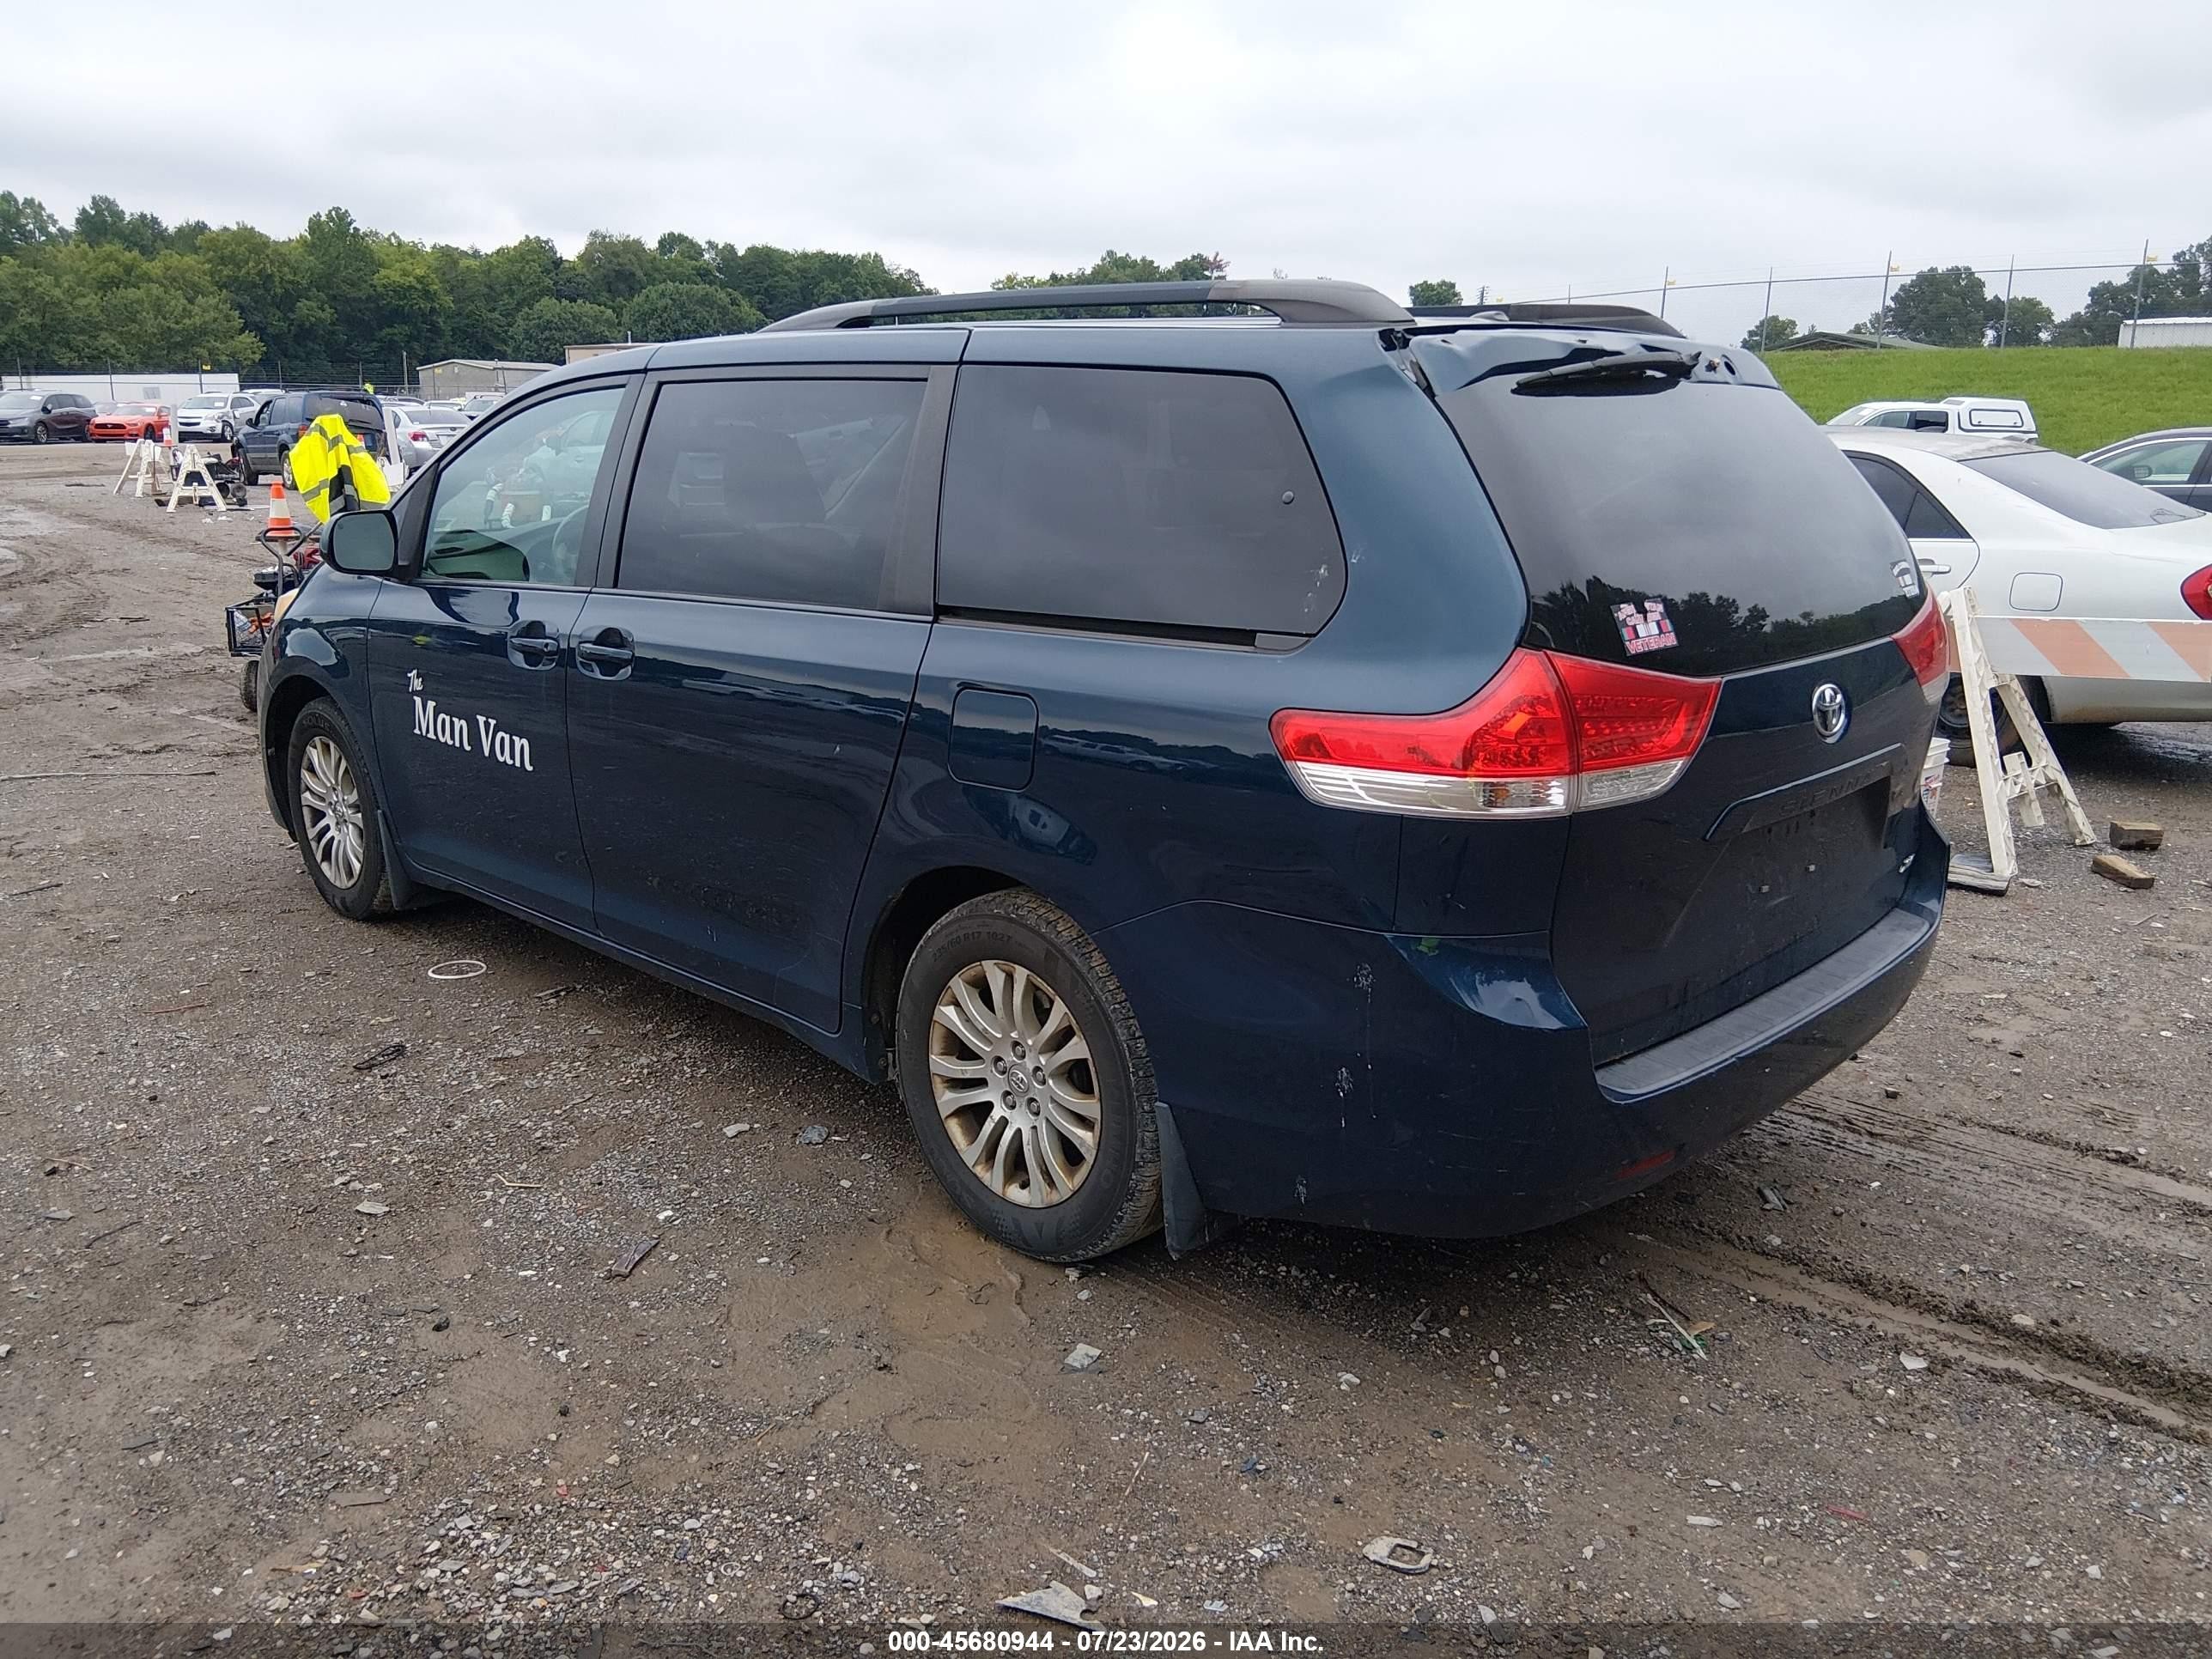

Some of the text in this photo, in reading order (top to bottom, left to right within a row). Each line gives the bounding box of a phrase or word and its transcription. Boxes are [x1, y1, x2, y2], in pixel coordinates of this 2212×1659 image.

[1626, 632, 1677, 653] VETERAN
[407, 669, 423, 692] The
[413, 696, 533, 771] Man Van
